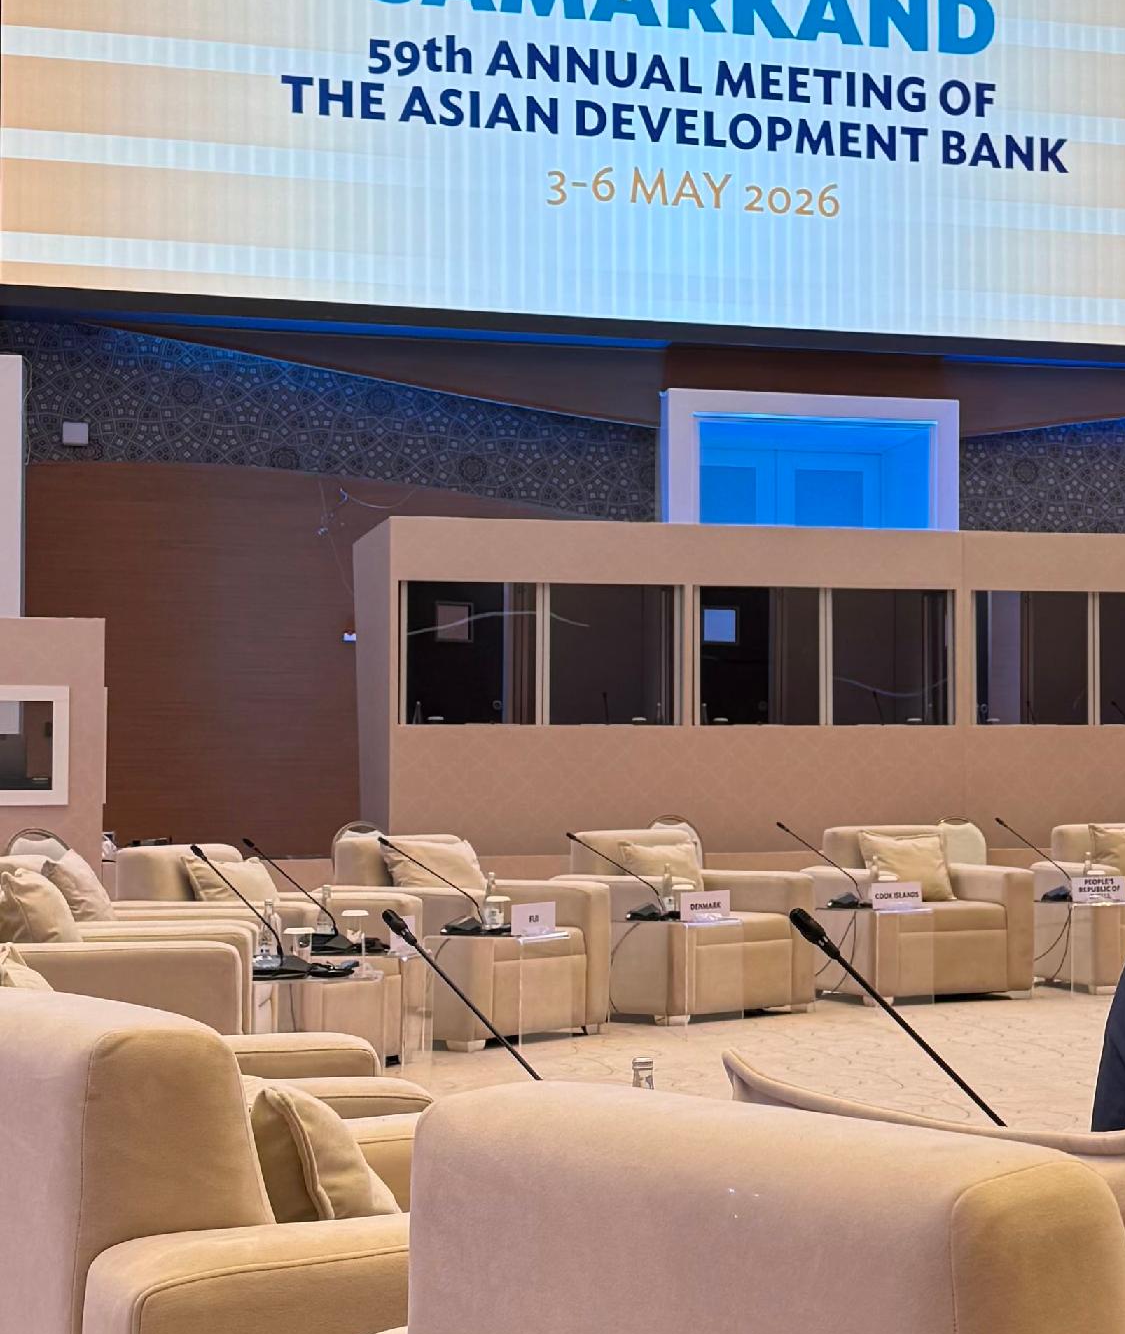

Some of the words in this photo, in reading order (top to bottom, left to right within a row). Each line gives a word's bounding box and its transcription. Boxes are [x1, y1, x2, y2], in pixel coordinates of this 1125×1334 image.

[368, 34, 473, 78] 59th
[484, 40, 704, 95] ANNUAL
[714, 60, 928, 114] MEETING
[938, 79, 997, 118] OF
[280, 74, 387, 121] THE
[397, 85, 560, 135] ASIAN
[574, 99, 930, 163] DEVELOPMENT
[941, 129, 1069, 174] BANK
[545, 166, 617, 206] 3-6
[629, 166, 733, 209] MAY
[743, 183, 841, 218] 2026
